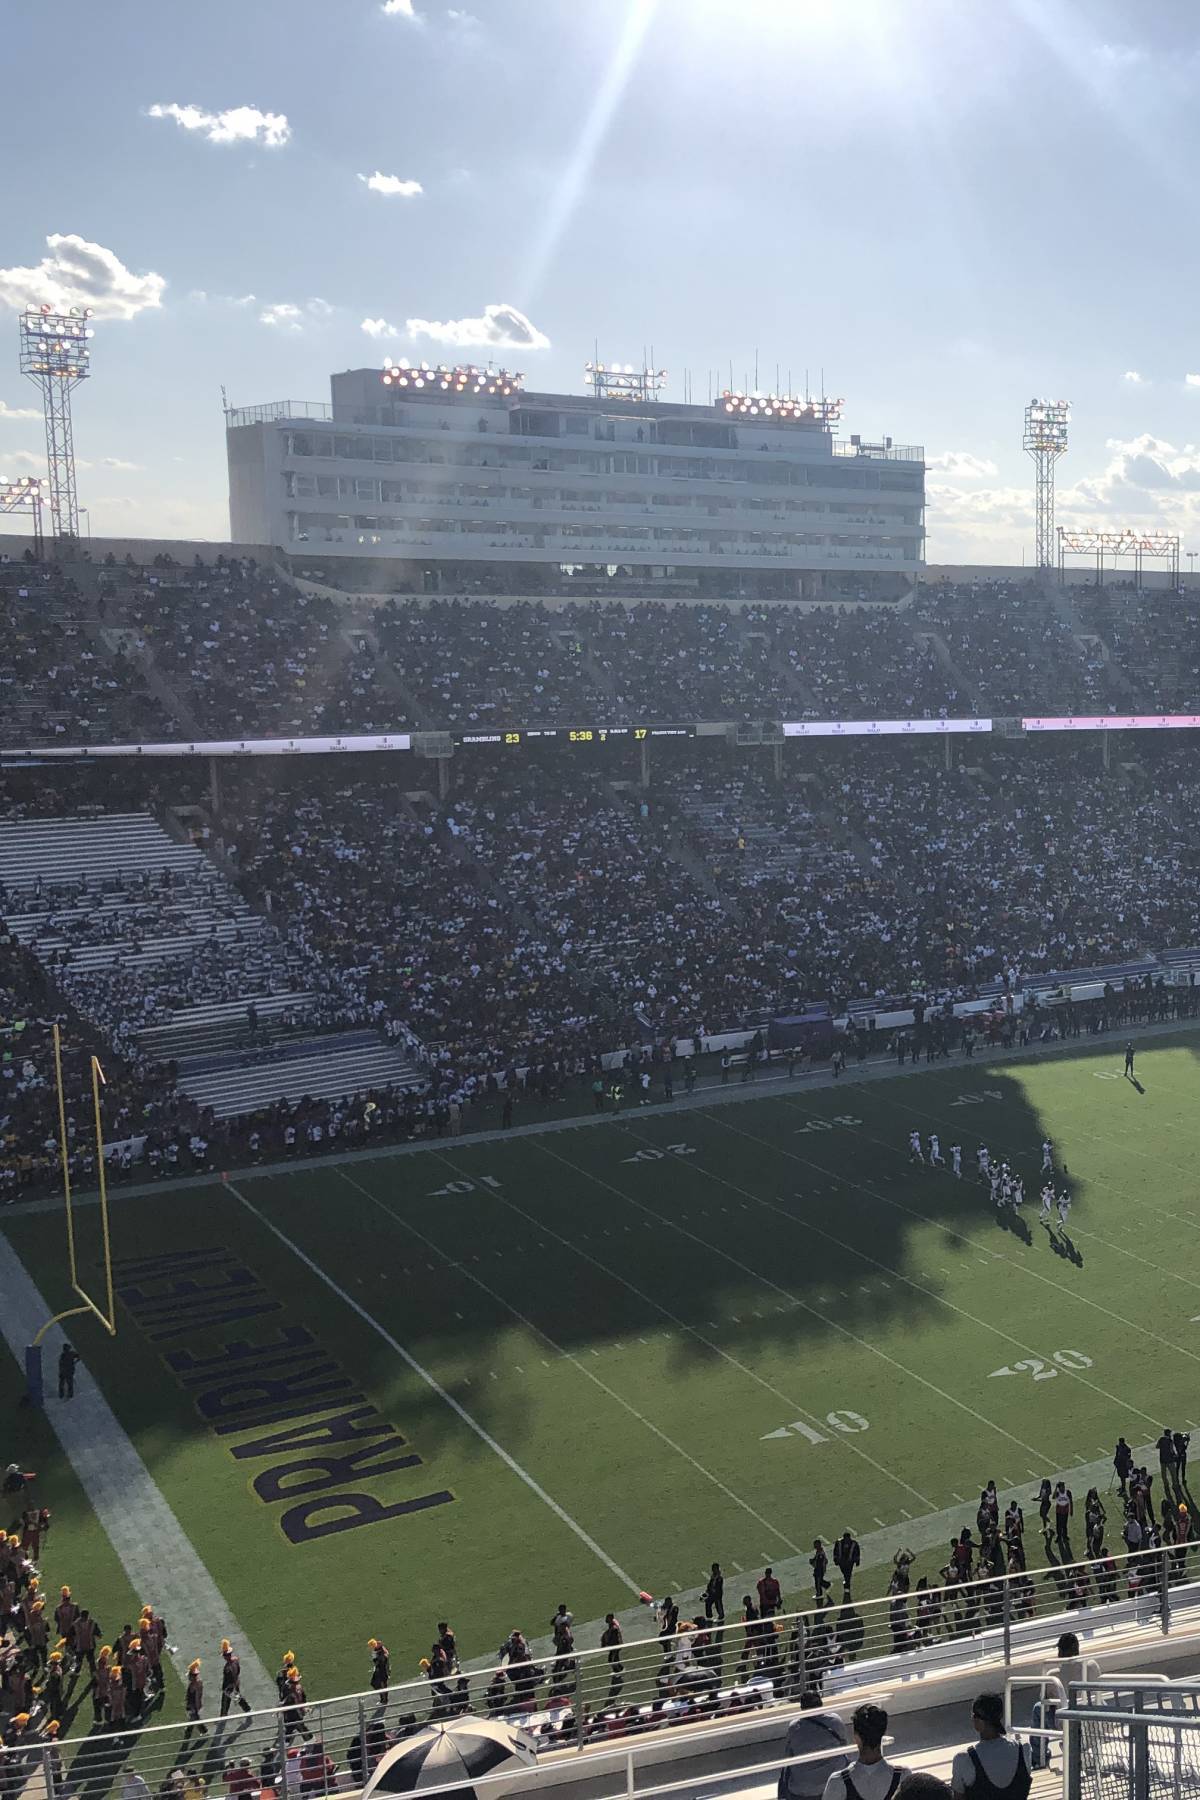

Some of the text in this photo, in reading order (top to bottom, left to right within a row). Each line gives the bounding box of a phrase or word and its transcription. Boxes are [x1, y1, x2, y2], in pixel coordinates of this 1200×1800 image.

[505, 733, 520, 743] 23
[634, 729, 647, 739] 17
[1014, 1350, 1093, 1382] 20
[162, 1325, 456, 1544] PRAIRIE
[791, 1410, 869, 1445] 10
